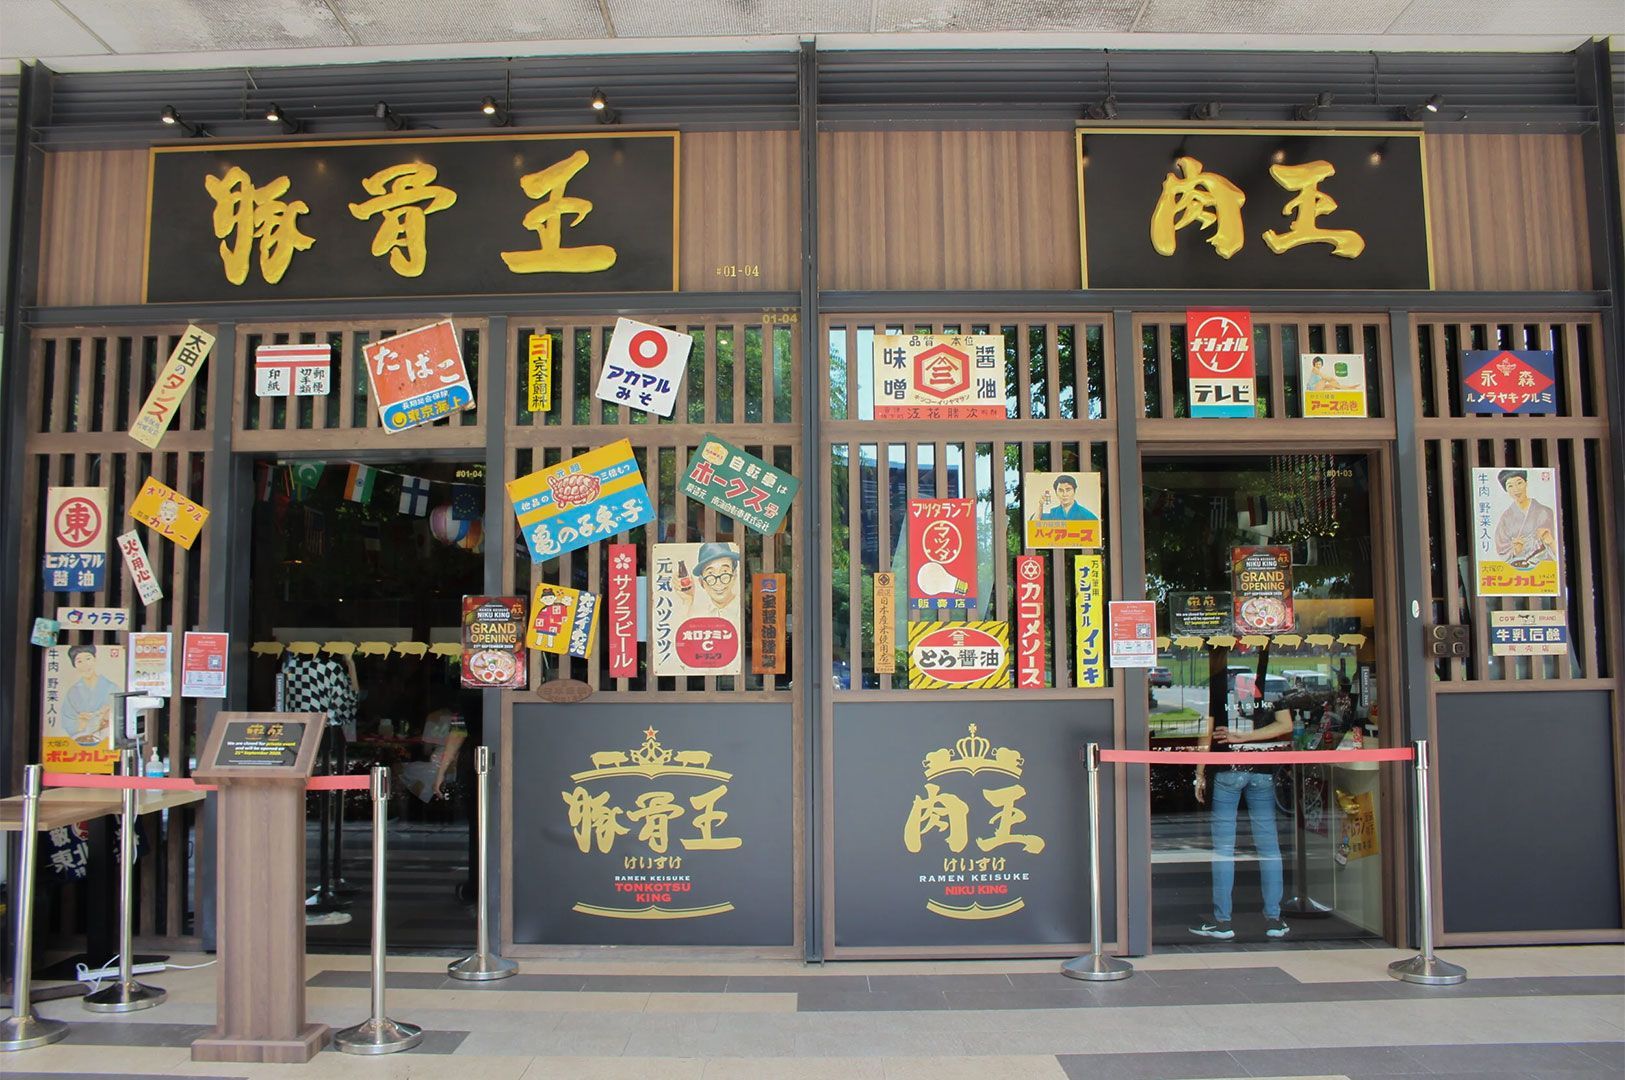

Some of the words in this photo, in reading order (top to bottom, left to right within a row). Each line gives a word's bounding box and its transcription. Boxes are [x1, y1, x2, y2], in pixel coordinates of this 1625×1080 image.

[204, 149, 618, 286] 豚骨王
[1150, 156, 1366, 260] 肉王
[716, 264, 760, 278] #01-04
[1190, 337, 1249, 352] ナショナル
[372, 345, 461, 384] たばこ
[883, 347, 907, 400] 味噌
[267, 368, 281, 392] 印紙
[532, 356, 549, 408] 完全飼料
[606, 364, 671, 394] アカマル
[615, 386, 653, 406] みそ
[1194, 384, 1249, 403] テレビ
[407, 395, 462, 423] 東京海上
[456, 470, 483, 478] #01-04
[728, 455, 789, 495] 自転車は
[1478, 472, 1490, 497] 牛肉
[689, 460, 780, 519] ホークス号
[147, 486, 203, 522] オリエンタル
[63, 502, 93, 542] 東
[150, 515, 188, 541] カレー
[1479, 502, 1492, 552] 野菜入り
[1034, 529, 1093, 542] ハイアース
[45, 553, 105, 569] ヒガシマル
[123, 538, 151, 583] 火の用心
[1240, 571, 1284, 582] GRAND
[1241, 582, 1285, 591] OPENING
[1482, 575, 1556, 587] ボンカレー
[87, 612, 126, 625] ウララ
[470, 623, 516, 634] GRAND
[613, 574, 634, 668] サクラビール
[470, 634, 516, 643] OPENING
[682, 630, 732, 640] オロナミン
[702, 640, 714, 651] C
[1020, 582, 1041, 686] カゴメソース
[48, 649, 59, 673] 牛肉
[47, 678, 59, 728] 野菜入り
[561, 784, 743, 854] 豚骨王
[903, 783, 1046, 855] 肉王
[624, 856, 682, 870] けいすけ
[944, 857, 1006, 872] けいすけ
[614, 882, 692, 892] TONKOTSU
[919, 874, 965, 883] RAMEN
[971, 873, 1030, 882] KEISUKE
[945, 885, 976, 896] NIKU
[978, 884, 1008, 894] KING
[636, 893, 672, 902] KING
